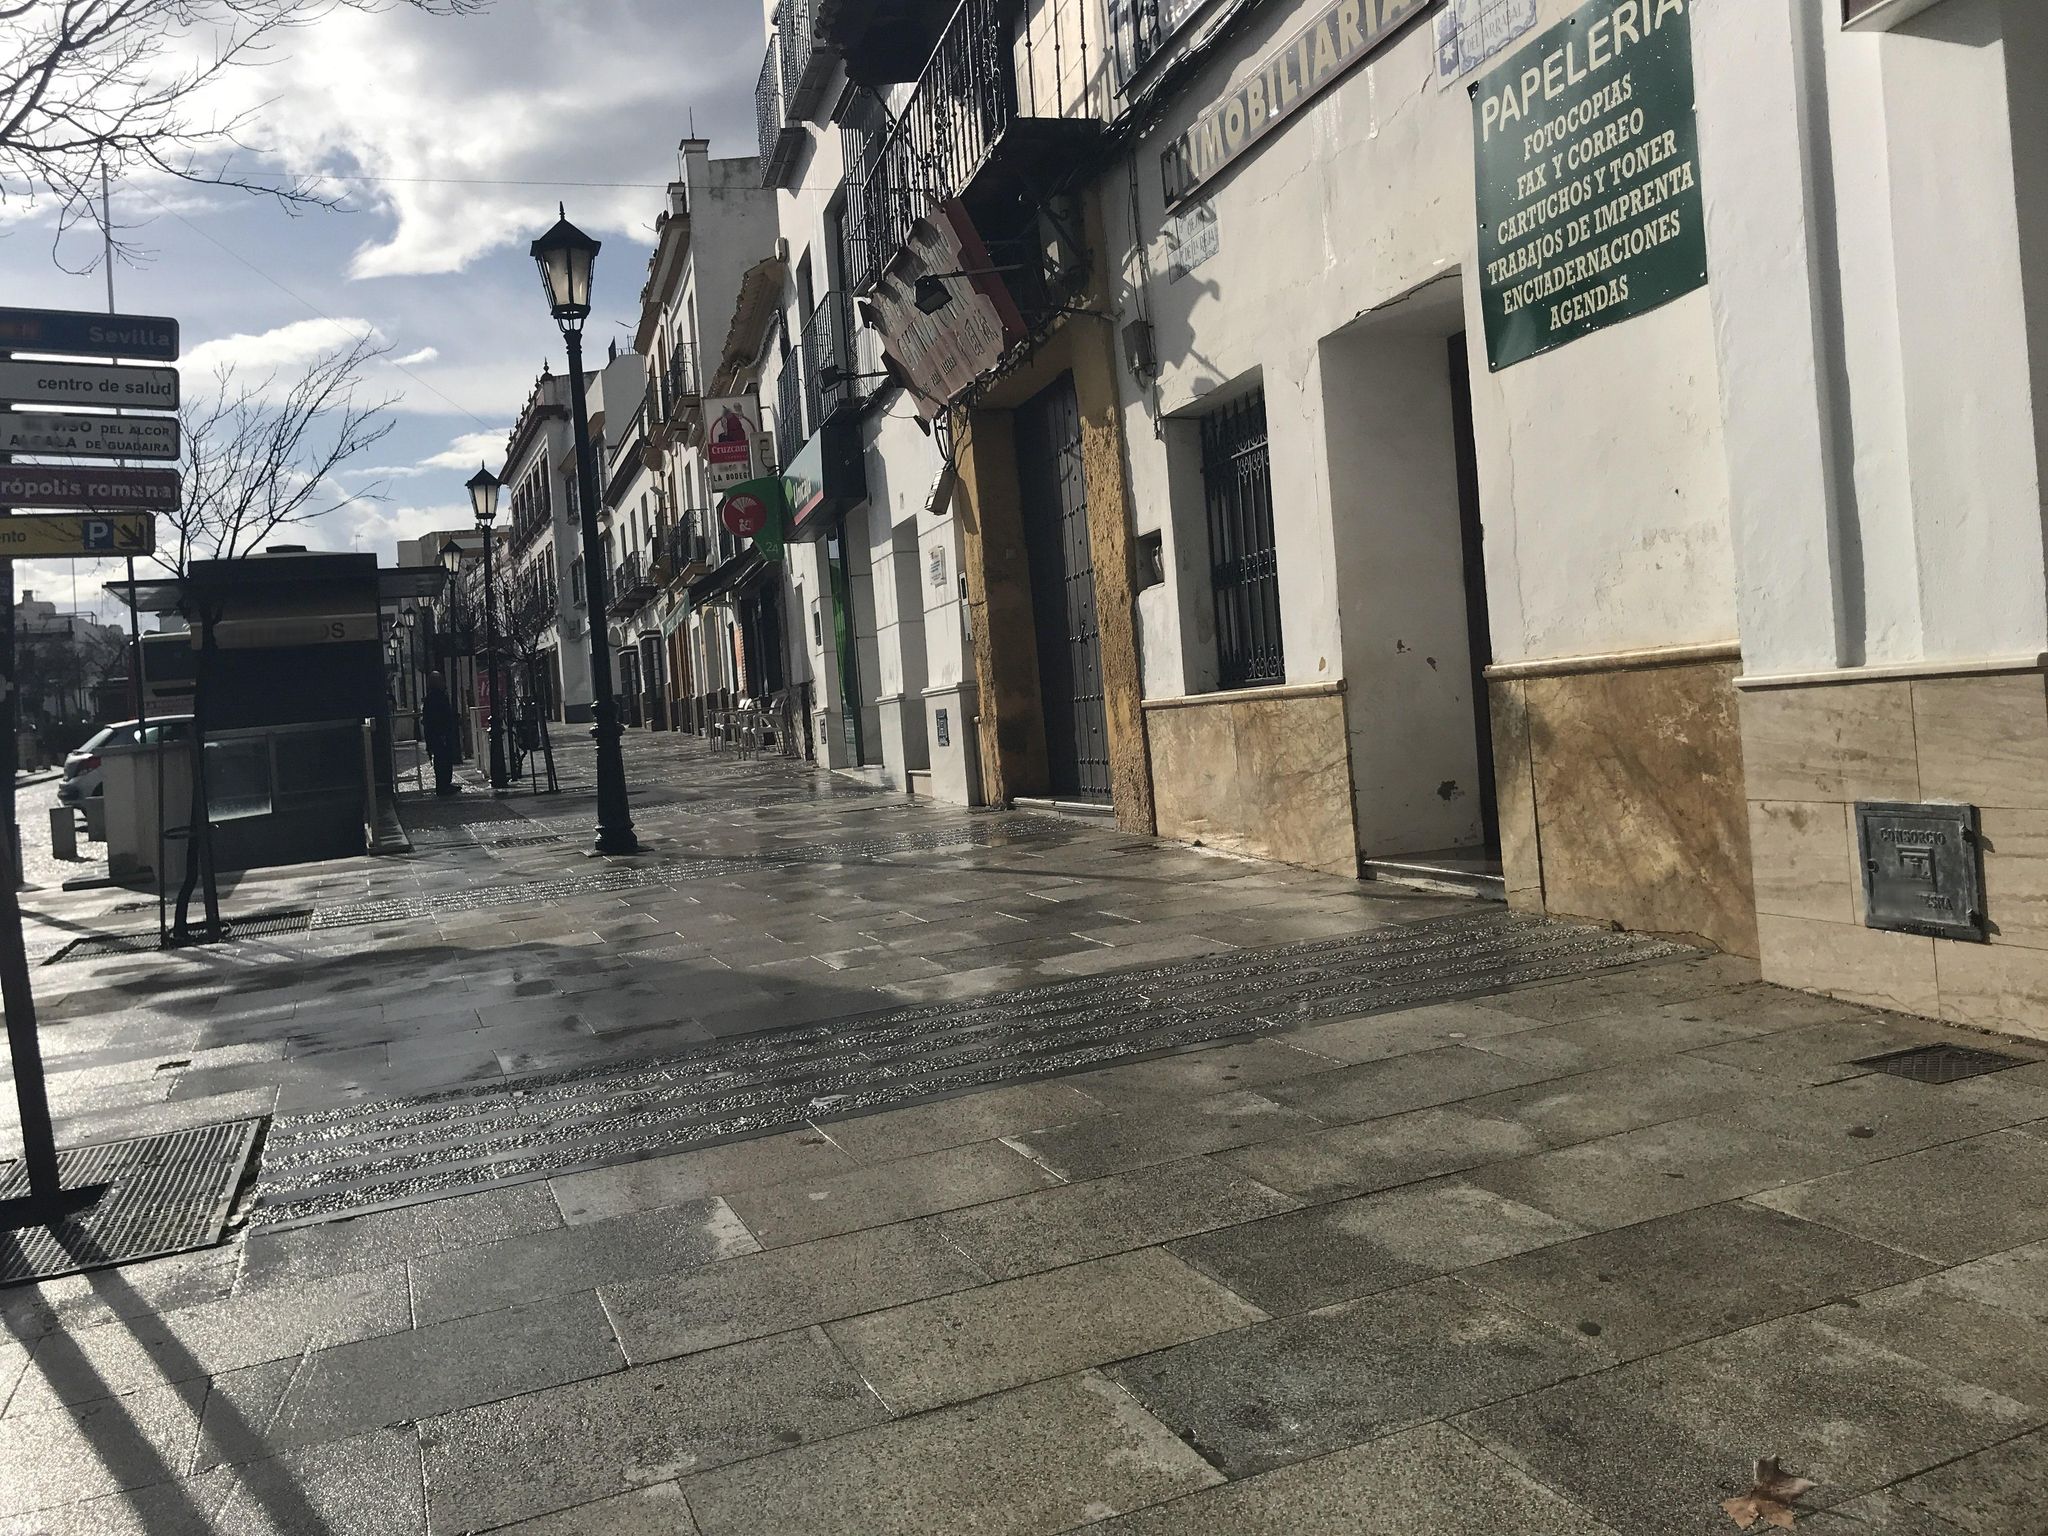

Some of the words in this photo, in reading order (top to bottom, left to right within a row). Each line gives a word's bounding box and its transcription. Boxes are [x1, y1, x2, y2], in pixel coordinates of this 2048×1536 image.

[1523, 73, 1632, 162] FOTOCOPIAS
[1517, 163, 1547, 200] FAX
[1552, 152, 1563, 179] Y
[1567, 107, 1644, 170] CORREO
[1498, 174, 1592, 245] CARTUCHOS
[1594, 166, 1606, 194] Y
[1610, 129, 1677, 186] TONER
[1487, 227, 1563, 285] TRABAJOS
[1567, 214, 1590, 247] DE
[1593, 160, 1694, 234] IMPRENTA
[1502, 209, 1681, 315] ENCUADERNACIONES
[1550, 274, 1629, 331] AGENDAS
[89, 326, 171, 347] Sevilla
[38, 378, 93, 392] centro
[99, 379, 119, 392] de
[125, 382, 171, 395] salud
[101, 424, 124, 435] DEL
[129, 425, 170, 436] ALCOR
[10, 434, 77, 448] AAA
[86, 440, 100, 449] DE
[108, 441, 170, 452] GUADAIRA
[88, 482, 172, 498] romana
[713, 474, 722, 482] LA
[88, 521, 109, 548] P
[1879, 827, 1948, 846] CONSORCIO
